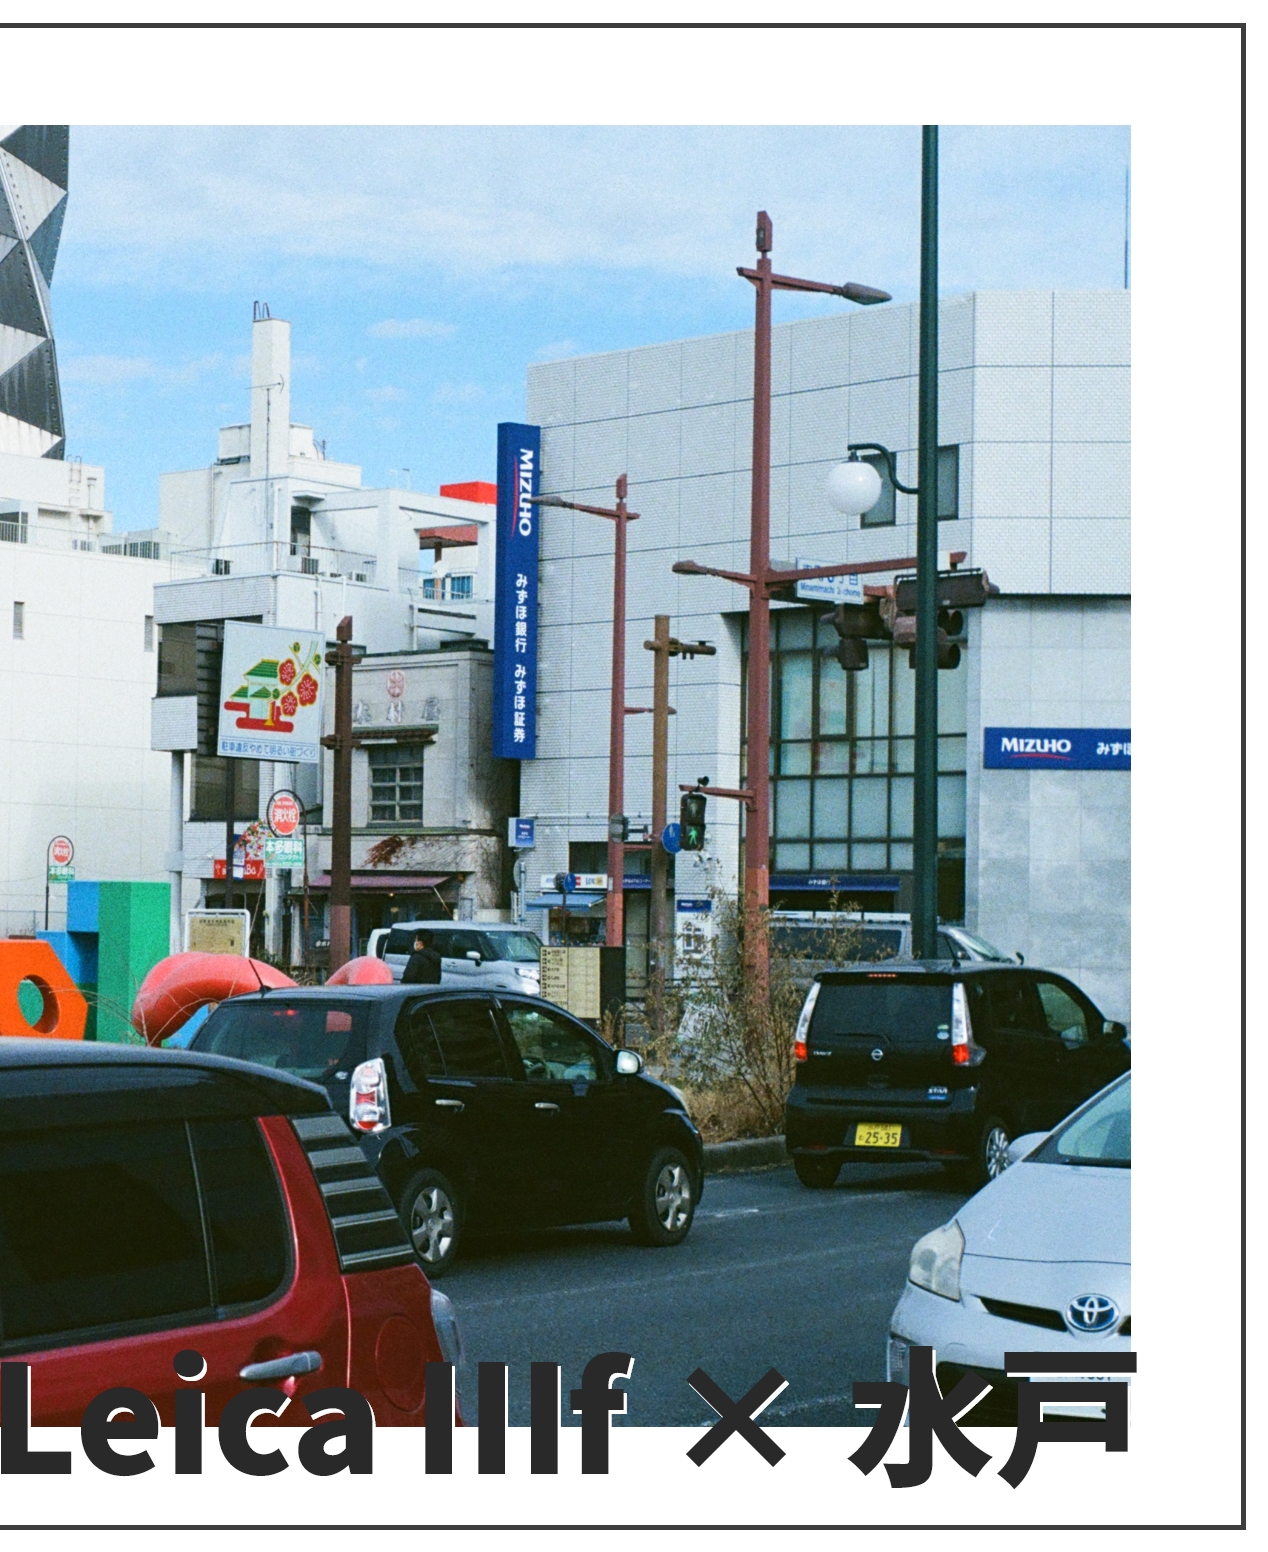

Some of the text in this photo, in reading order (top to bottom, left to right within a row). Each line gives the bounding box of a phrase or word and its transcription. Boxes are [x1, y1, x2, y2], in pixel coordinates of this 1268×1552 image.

[518, 448, 533, 537] MIZUHO
[513, 573, 528, 743] みずほ銀行 みずほ証券
[1000, 737, 1072, 754] MIZUHO
[273, 808, 297, 823] 消火栓
[864, 1131, 898, 1145] 25-35
